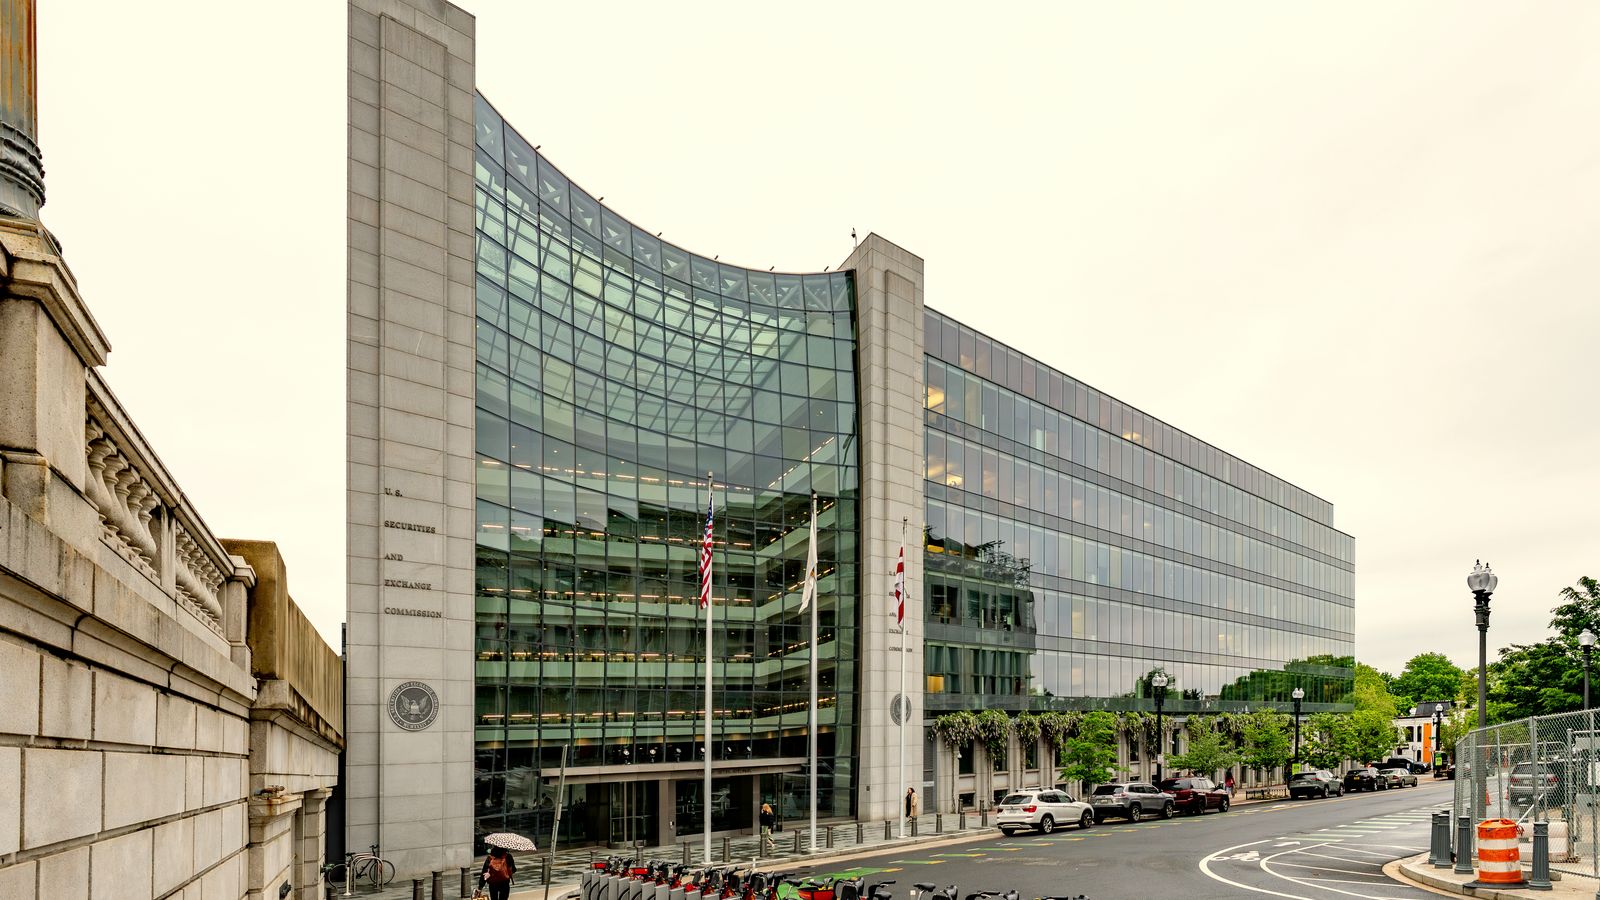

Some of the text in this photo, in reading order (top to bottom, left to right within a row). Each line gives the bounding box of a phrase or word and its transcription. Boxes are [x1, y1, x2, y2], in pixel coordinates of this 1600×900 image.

[384, 520, 436, 534] SECURITIES
[384, 553, 404, 562] AND
[384, 579, 432, 590] EXCHANGE
[384, 607, 442, 618] COMMISSION
